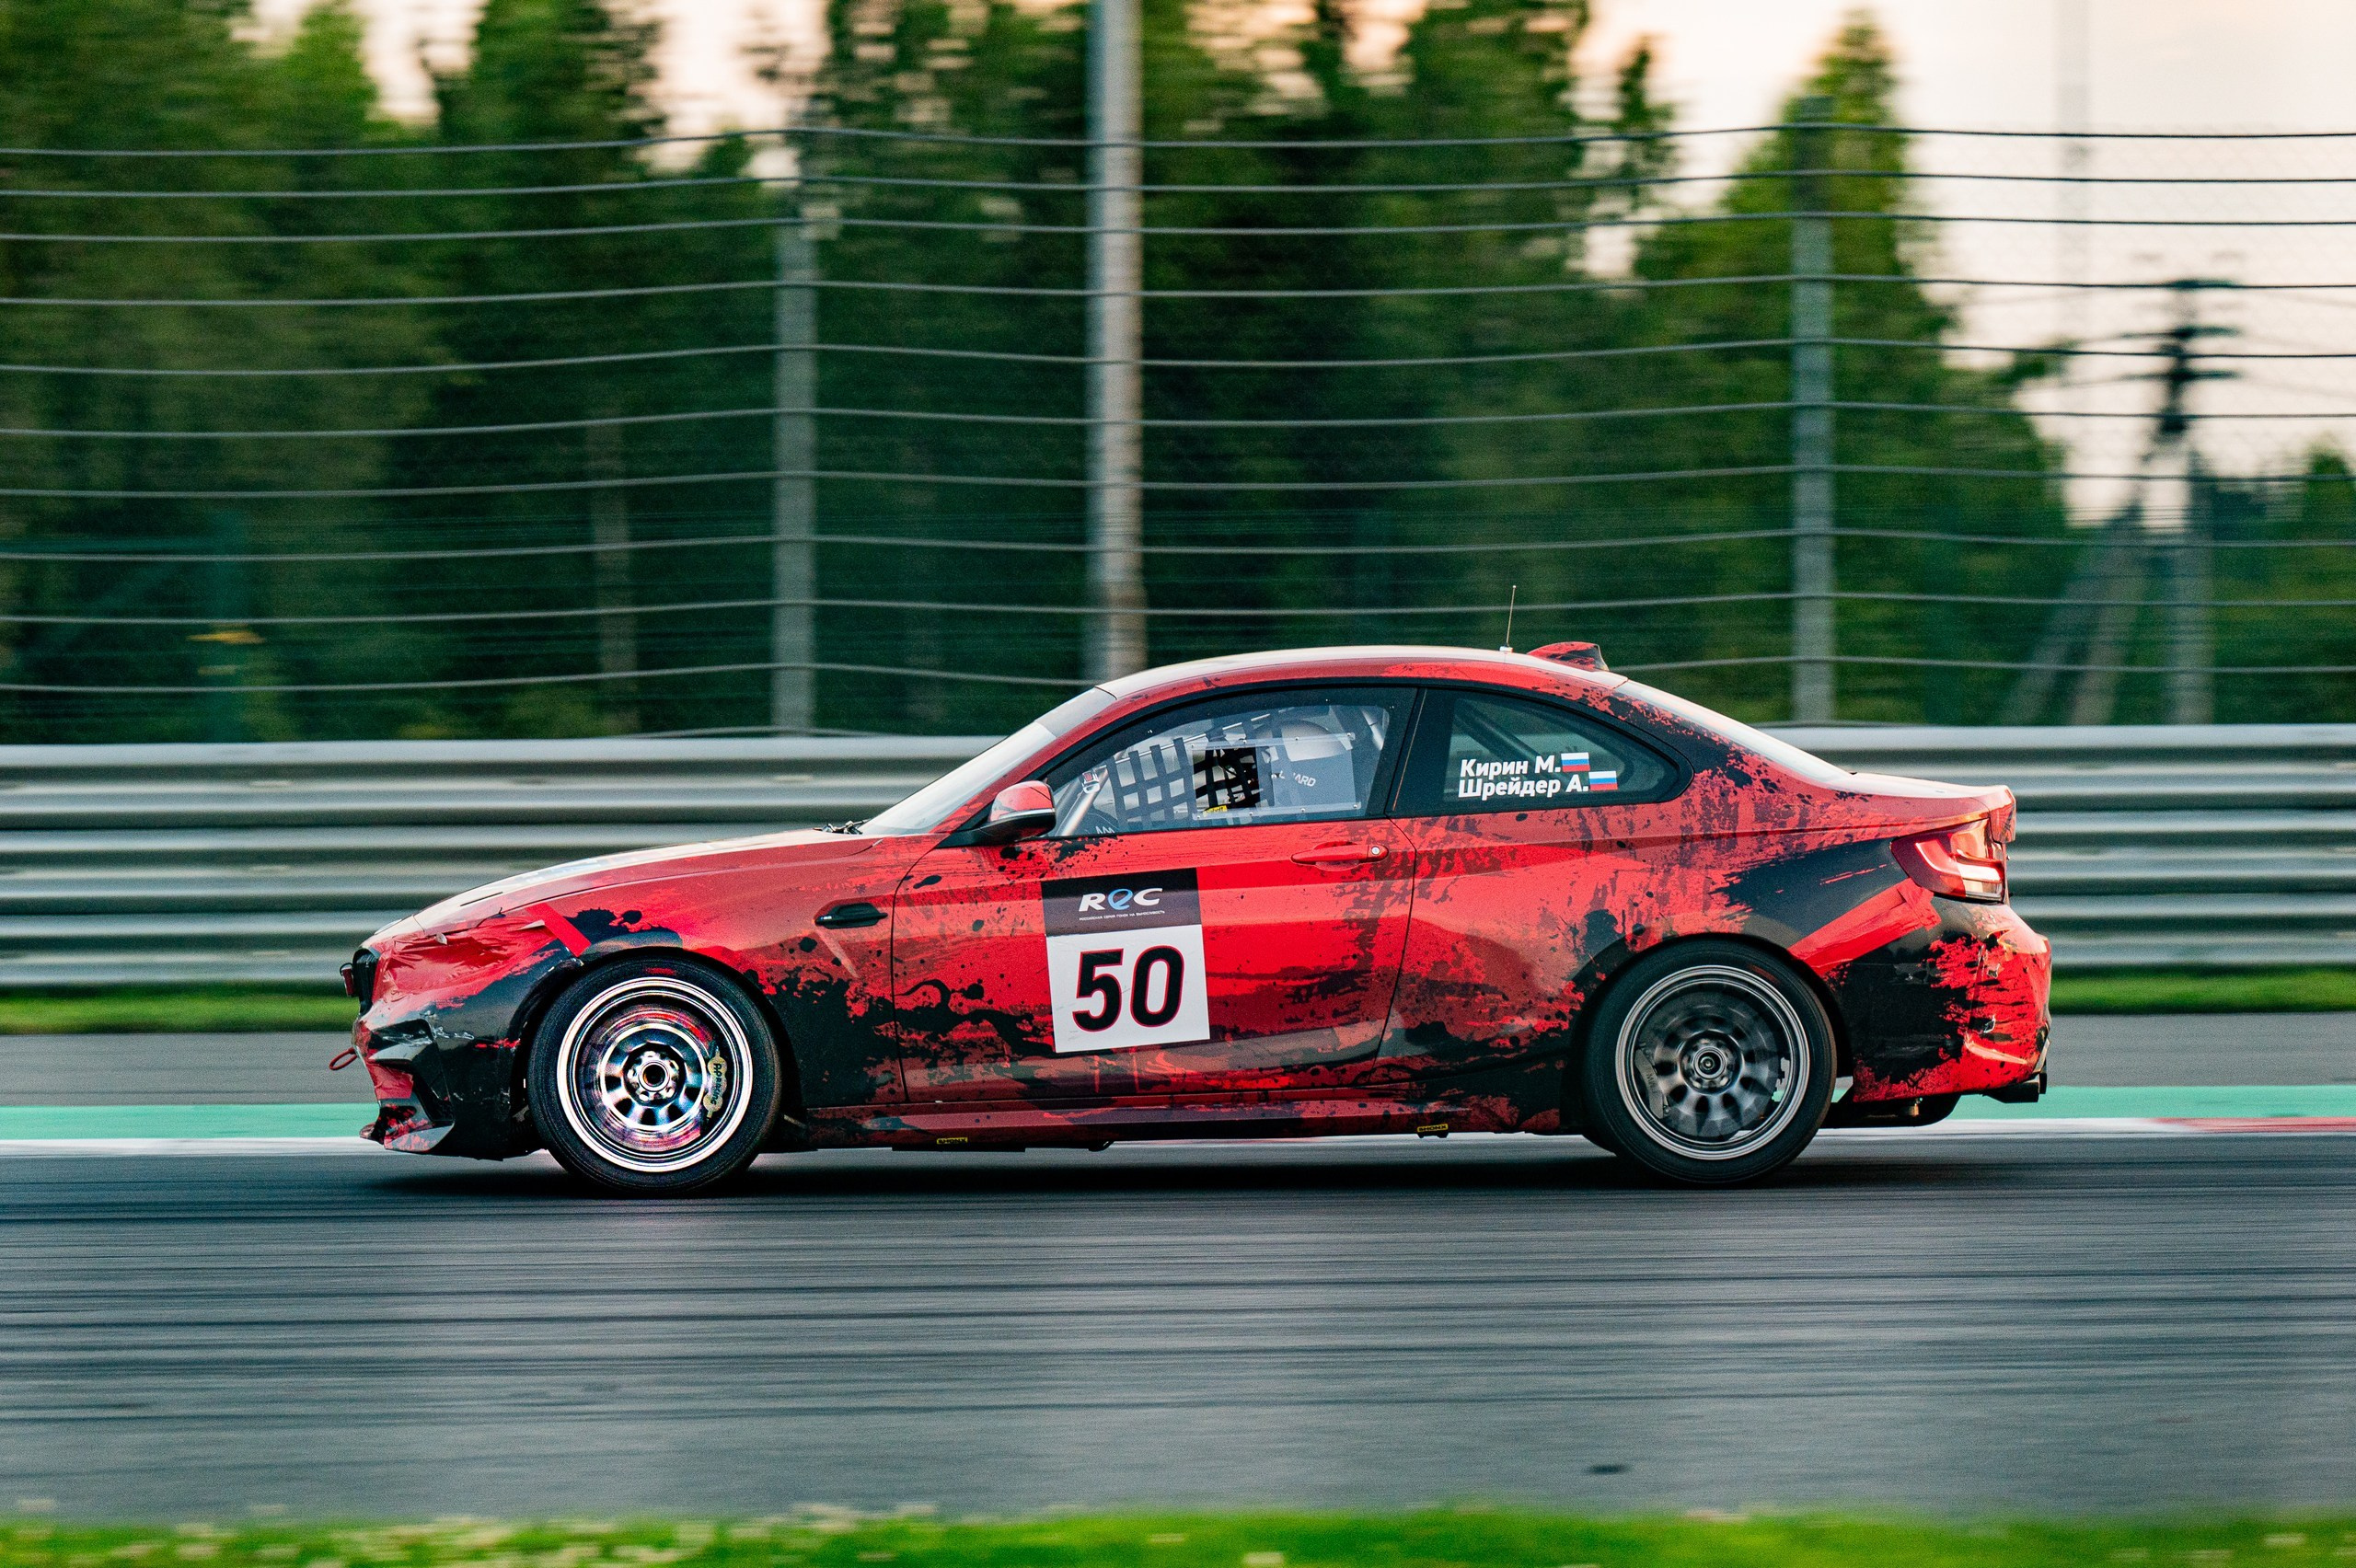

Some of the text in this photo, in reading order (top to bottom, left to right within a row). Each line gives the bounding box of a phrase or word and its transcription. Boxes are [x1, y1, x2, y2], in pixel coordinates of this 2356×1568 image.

[1460, 755, 1562, 779] Кирин М.
[1458, 774, 1589, 801] Шрейдер А.
[1072, 945, 1185, 1033] 50
